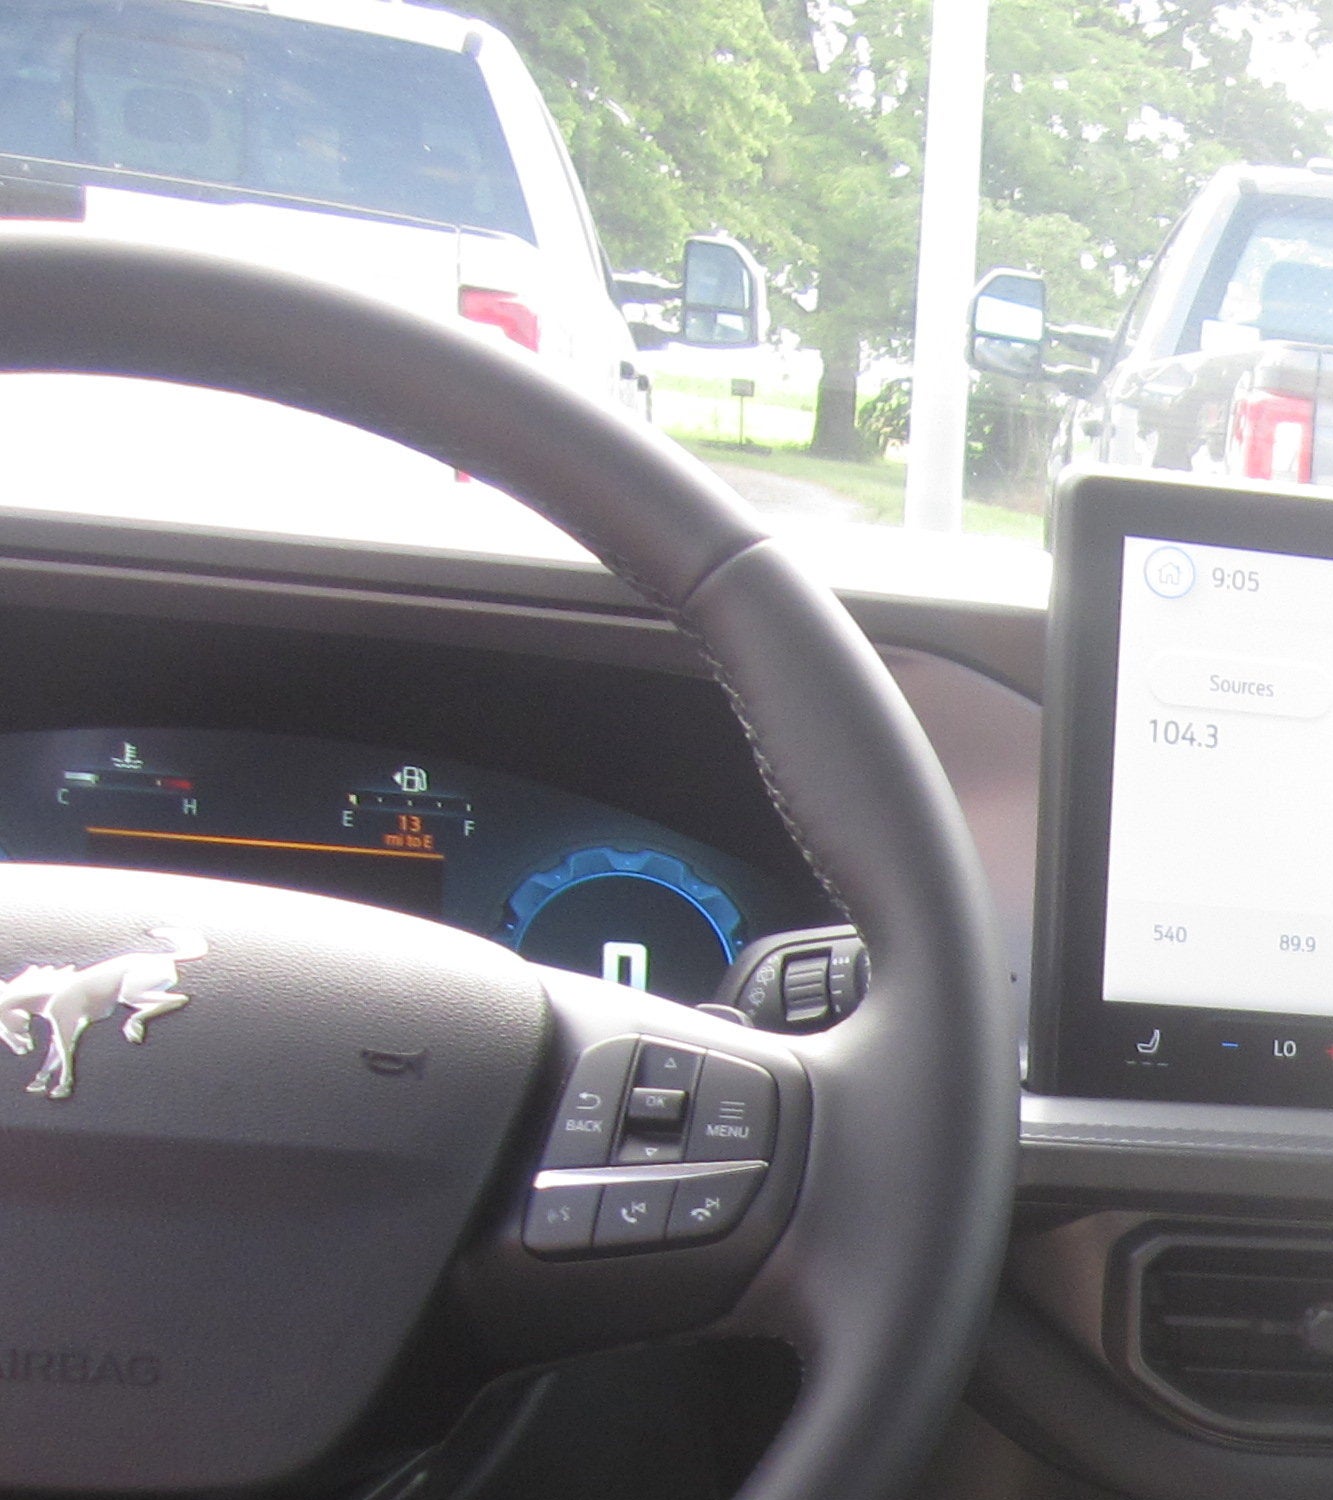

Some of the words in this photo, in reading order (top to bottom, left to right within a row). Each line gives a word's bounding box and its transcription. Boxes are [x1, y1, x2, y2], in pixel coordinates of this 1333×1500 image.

[1211, 567, 1260, 593] 9:05
[1209, 674, 1275, 698] Sources
[1148, 718, 1219, 749] 104.3
[183, 799, 197, 815] H
[342, 810, 354, 827] E
[397, 815, 422, 832] 13
[464, 820, 475, 836] F
[1153, 924, 1188, 944] 540
[1279, 935, 1316, 954] 89.9
[1273, 1038, 1297, 1058] LO
[565, 1119, 603, 1133] BACK
[706, 1124, 749, 1138] MENU
